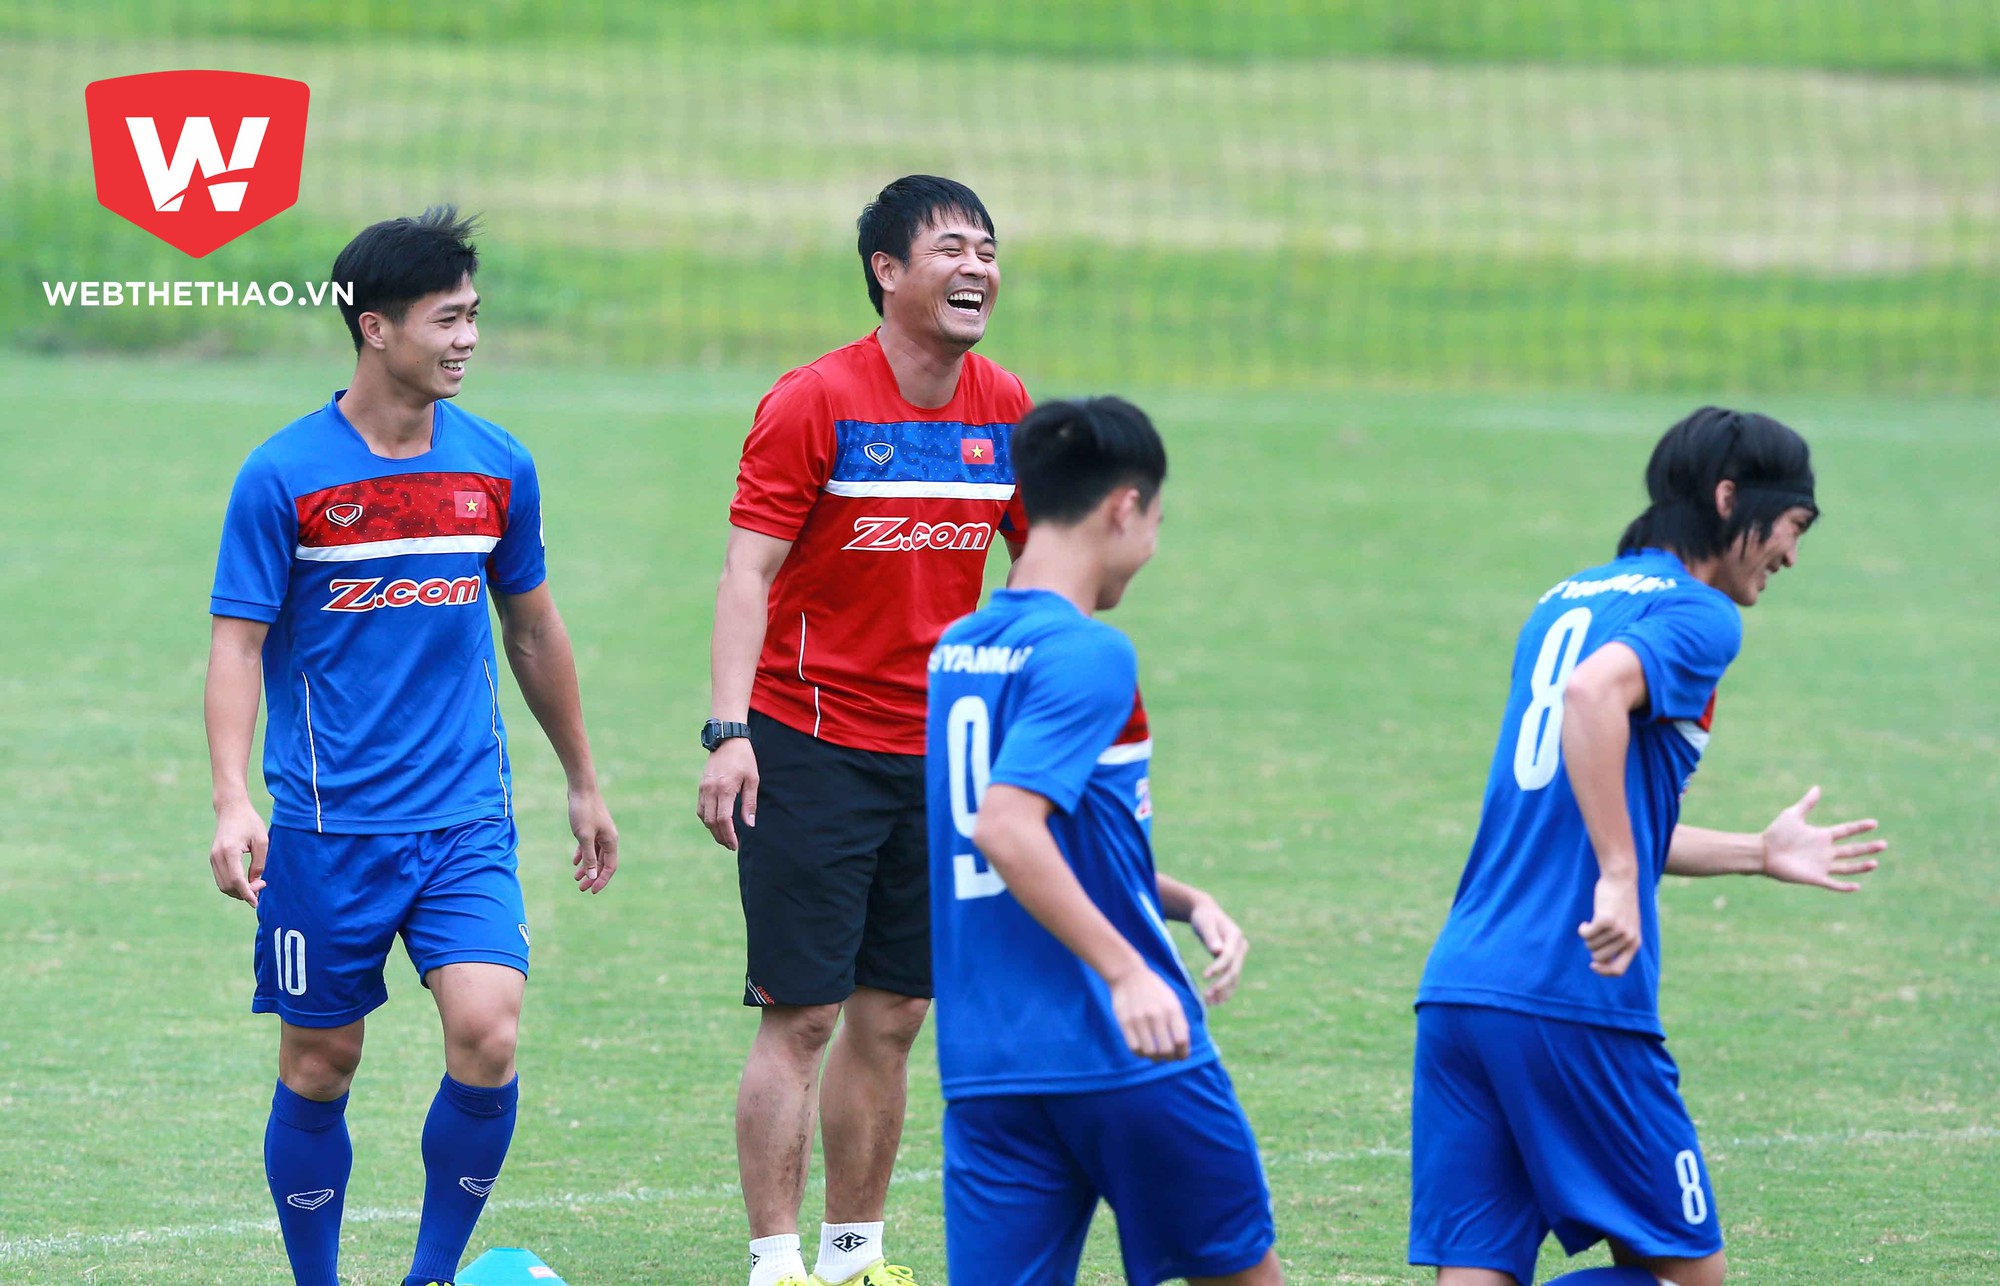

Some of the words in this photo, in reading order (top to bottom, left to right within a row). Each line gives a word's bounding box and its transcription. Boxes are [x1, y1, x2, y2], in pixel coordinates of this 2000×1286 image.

[841, 516, 991, 551] Z.com
[320, 575, 481, 612] Z.com
[1513, 606, 1592, 791] 8
[274, 926, 307, 996] 10
[1675, 1149, 1707, 1225] 8
